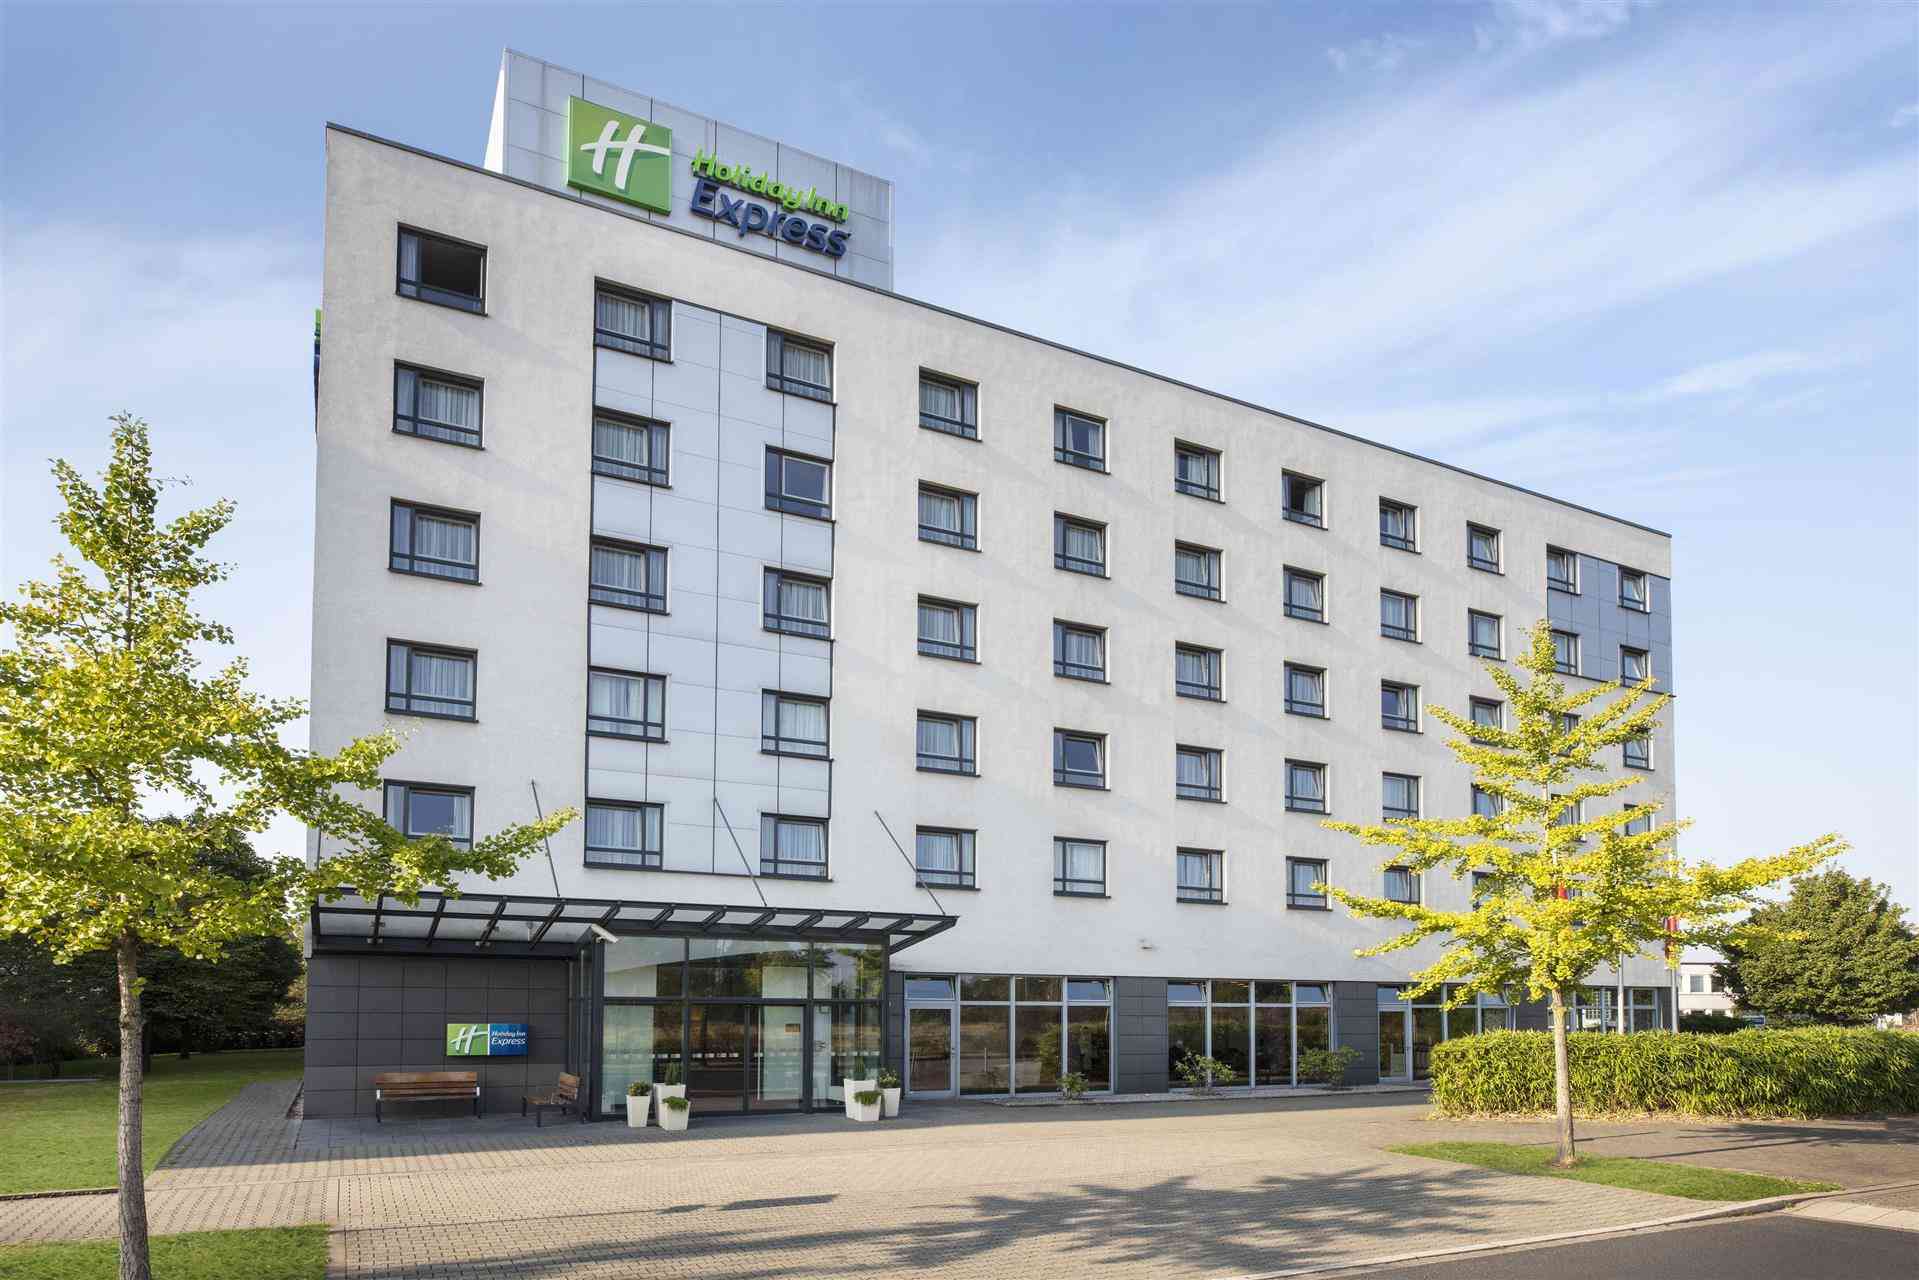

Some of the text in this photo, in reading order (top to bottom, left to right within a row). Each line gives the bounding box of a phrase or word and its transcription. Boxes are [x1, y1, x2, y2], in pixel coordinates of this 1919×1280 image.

[690, 148, 849, 224] Holiday Inn
[689, 178, 852, 258] Express
[491, 1030, 516, 1038] Holiday
[491, 1037, 526, 1047] Express
